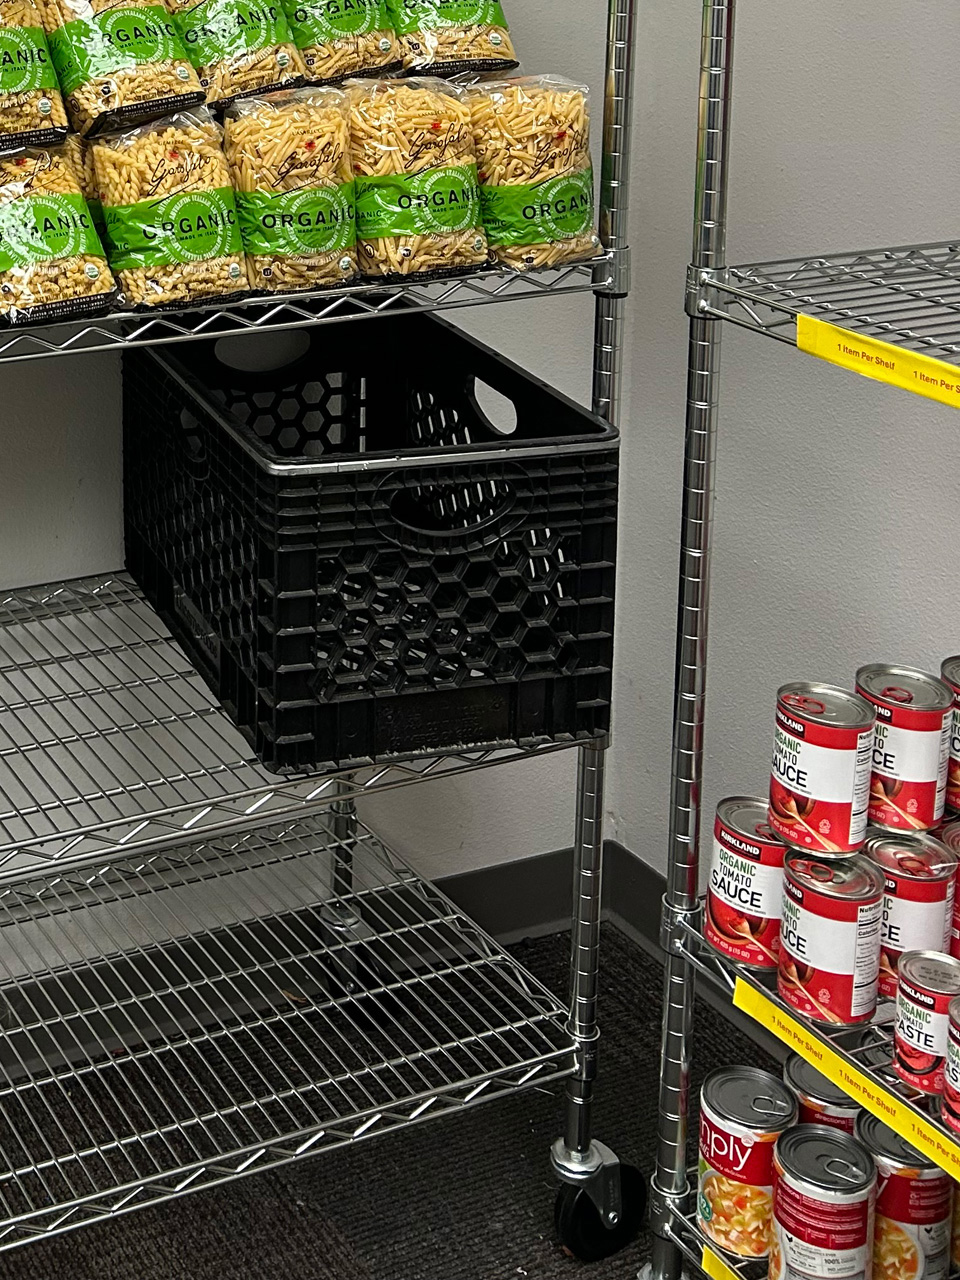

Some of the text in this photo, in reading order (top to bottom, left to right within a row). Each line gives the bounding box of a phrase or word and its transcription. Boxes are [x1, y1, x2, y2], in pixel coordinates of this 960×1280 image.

[405, 121, 469, 168] Garofalo
[148, 152, 218, 195] Garofalo
[273, 141, 344, 186] Garofalo
[397, 185, 482, 210] ORGANIC
[522, 197, 589, 220] ORGAN
[142, 209, 236, 240] ORGANIC
[261, 203, 355, 229] ORGANIC
[837, 343, 895, 370] 1 Item Per Shelf
[913, 370, 954, 392] 1 Item Per
[721, 830, 760, 855] KIRKLAND
[719, 848, 757, 877] ORGANIC
[720, 862, 752, 888] TOMATO
[711, 869, 762, 909] SAUCE
[899, 995, 932, 1024] ORGANIC
[901, 1009, 923, 1030] TOMATO
[775, 1019, 792, 1037] Item
[792, 1031, 805, 1045] Per
[803, 1040, 823, 1061] Shelf
[843, 1072, 862, 1090] Item
[862, 1085, 875, 1102] Per
[875, 1096, 897, 1118] Shelf
[814, 1112, 846, 1126] directions
[700, 1119, 752, 1171] mply
[911, 1123, 951, 1158] 1 Item Per
